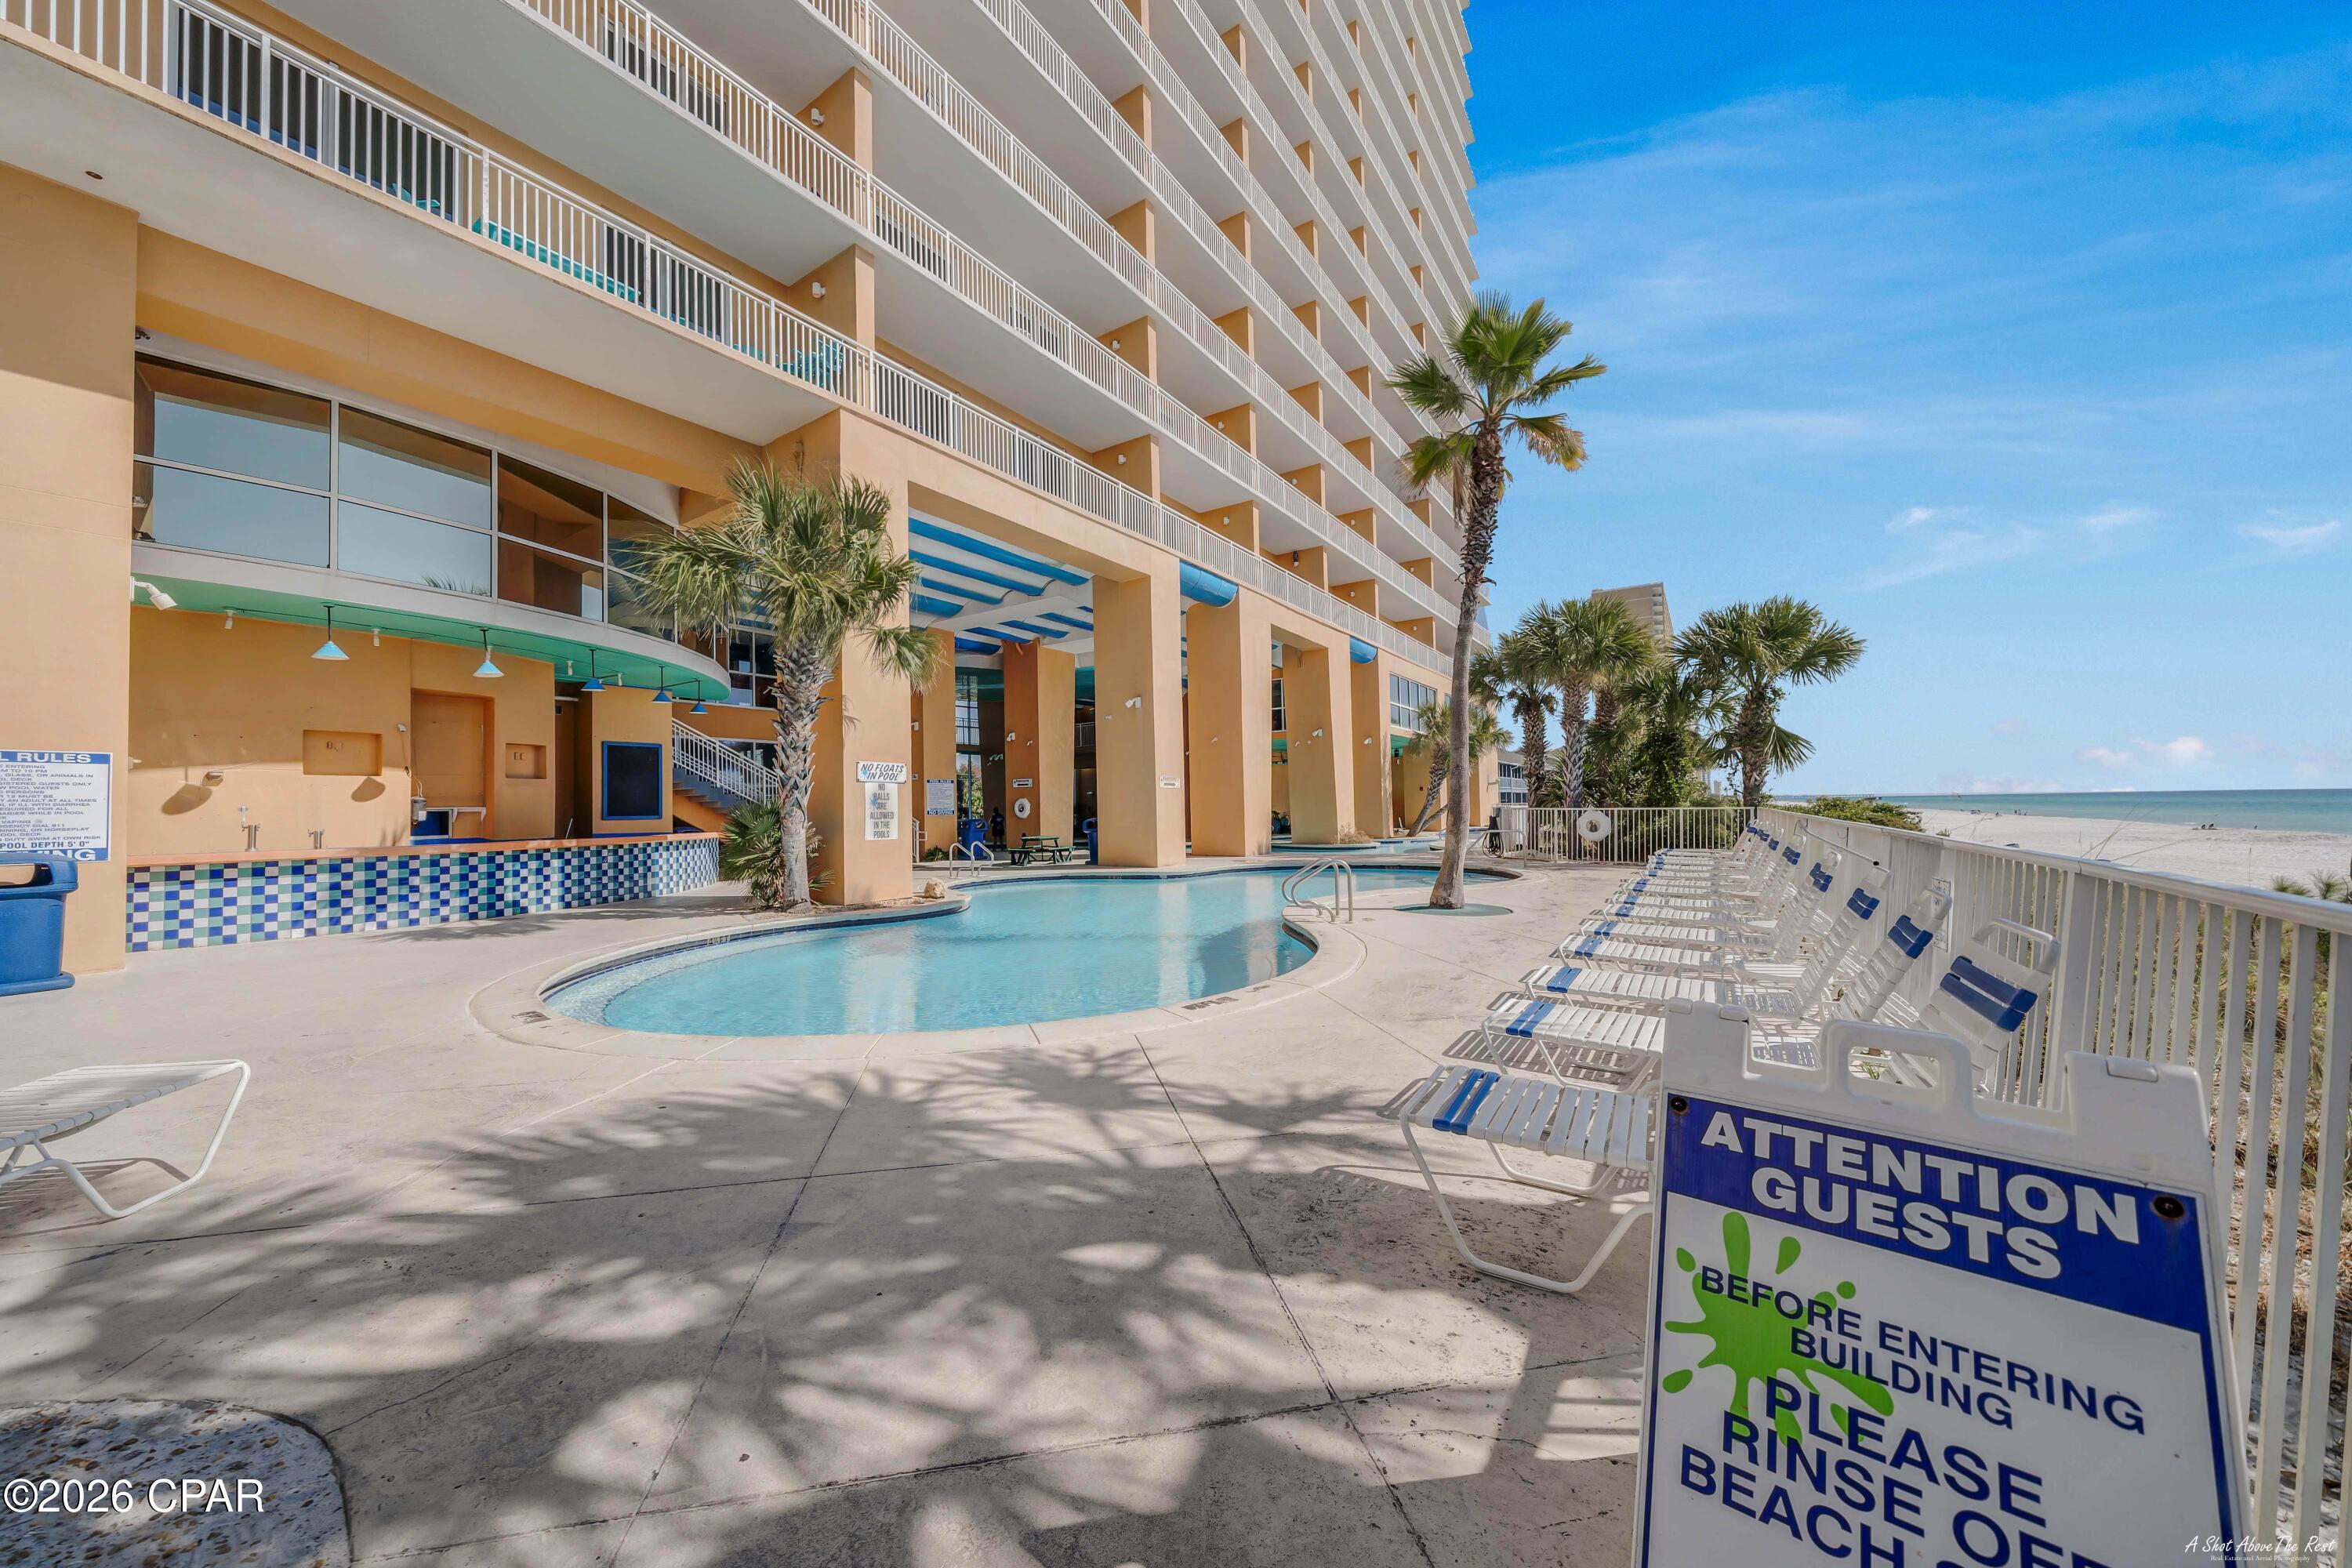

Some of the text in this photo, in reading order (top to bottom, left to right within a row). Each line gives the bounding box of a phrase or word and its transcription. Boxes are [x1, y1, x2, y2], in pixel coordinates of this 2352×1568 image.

[17, 753, 91, 763] RULES
[860, 764, 904, 773] NO FLOATS
[877, 772, 899, 781] POOL
[869, 811, 895, 820] ALLOWED
[873, 821, 879, 829] IN
[1700, 1110, 2140, 1245] ATTENTION
[1751, 1167, 2062, 1279] GUESTS
[1701, 1265, 2145, 1436] BEFORE ENTERING
[1791, 1326, 2013, 1430] BUILDING
[1680, 1443, 1905, 1568] BEACH
[1722, 1410, 1926, 1538] RINSE
[1766, 1375, 2046, 1528] PLEASE
